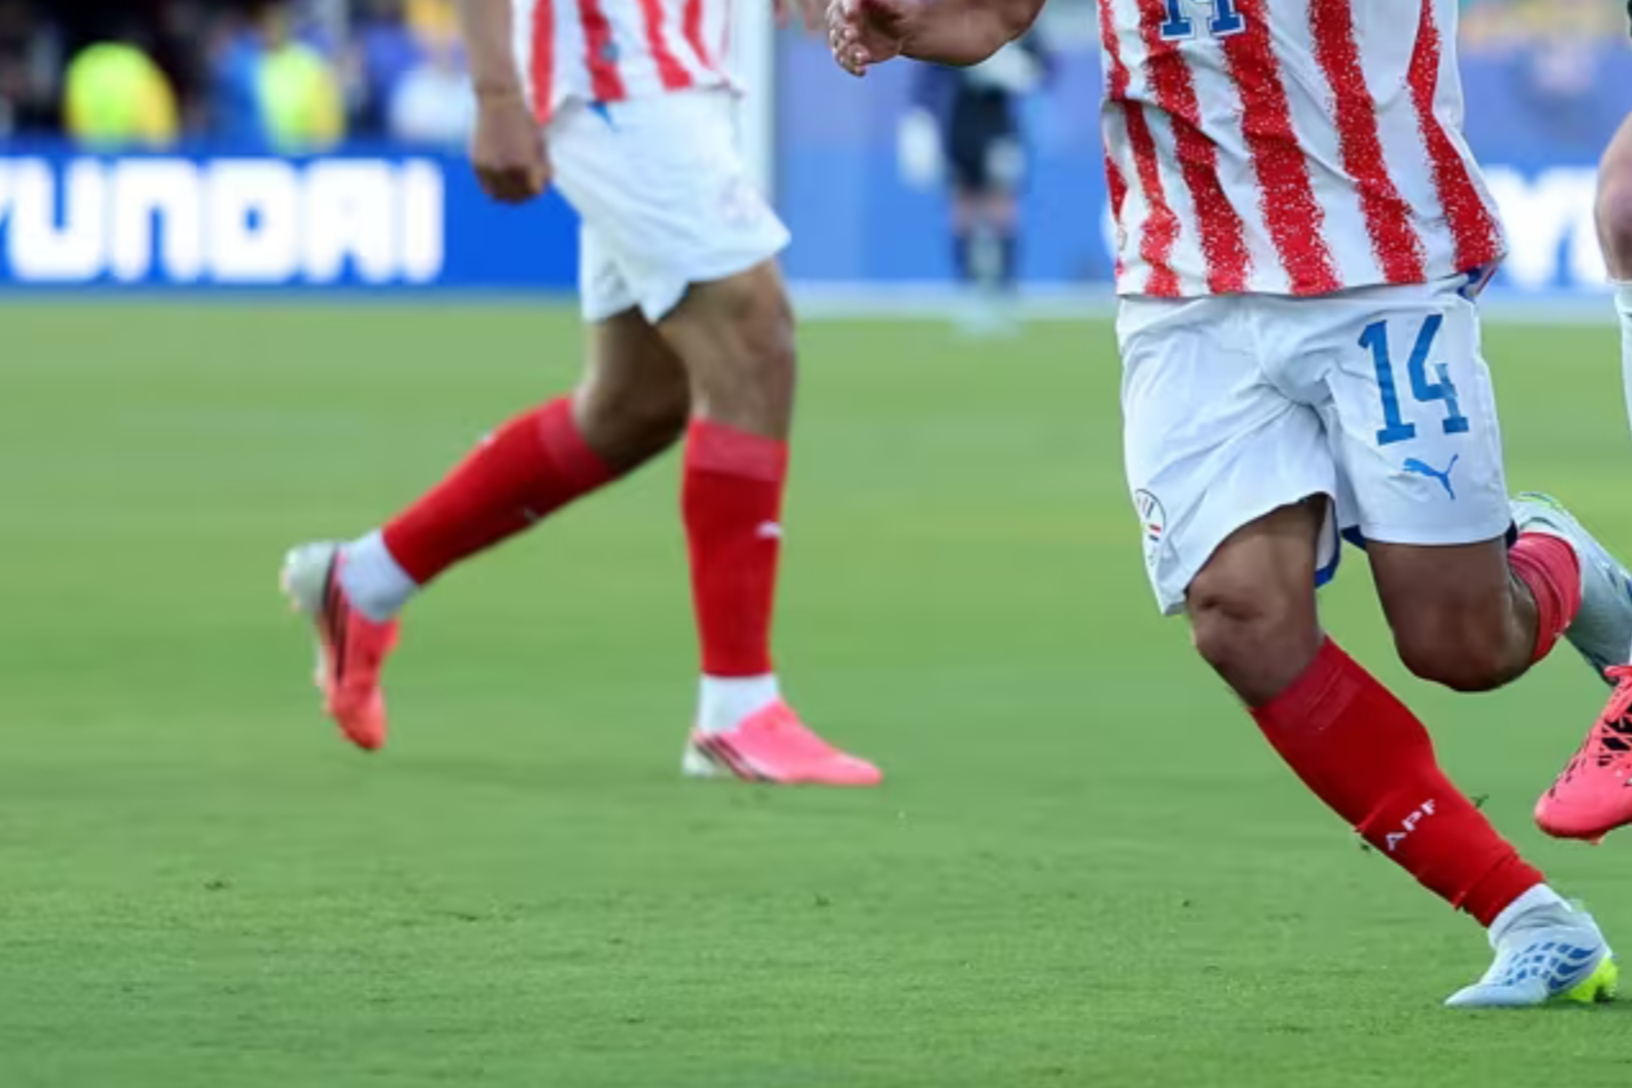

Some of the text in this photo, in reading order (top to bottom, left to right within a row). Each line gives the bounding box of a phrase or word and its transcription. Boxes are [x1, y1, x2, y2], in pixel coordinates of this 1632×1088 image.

[0, 157, 445, 283] UNDAI
[1357, 313, 1470, 446] 14
[1385, 798, 1436, 851] APF
